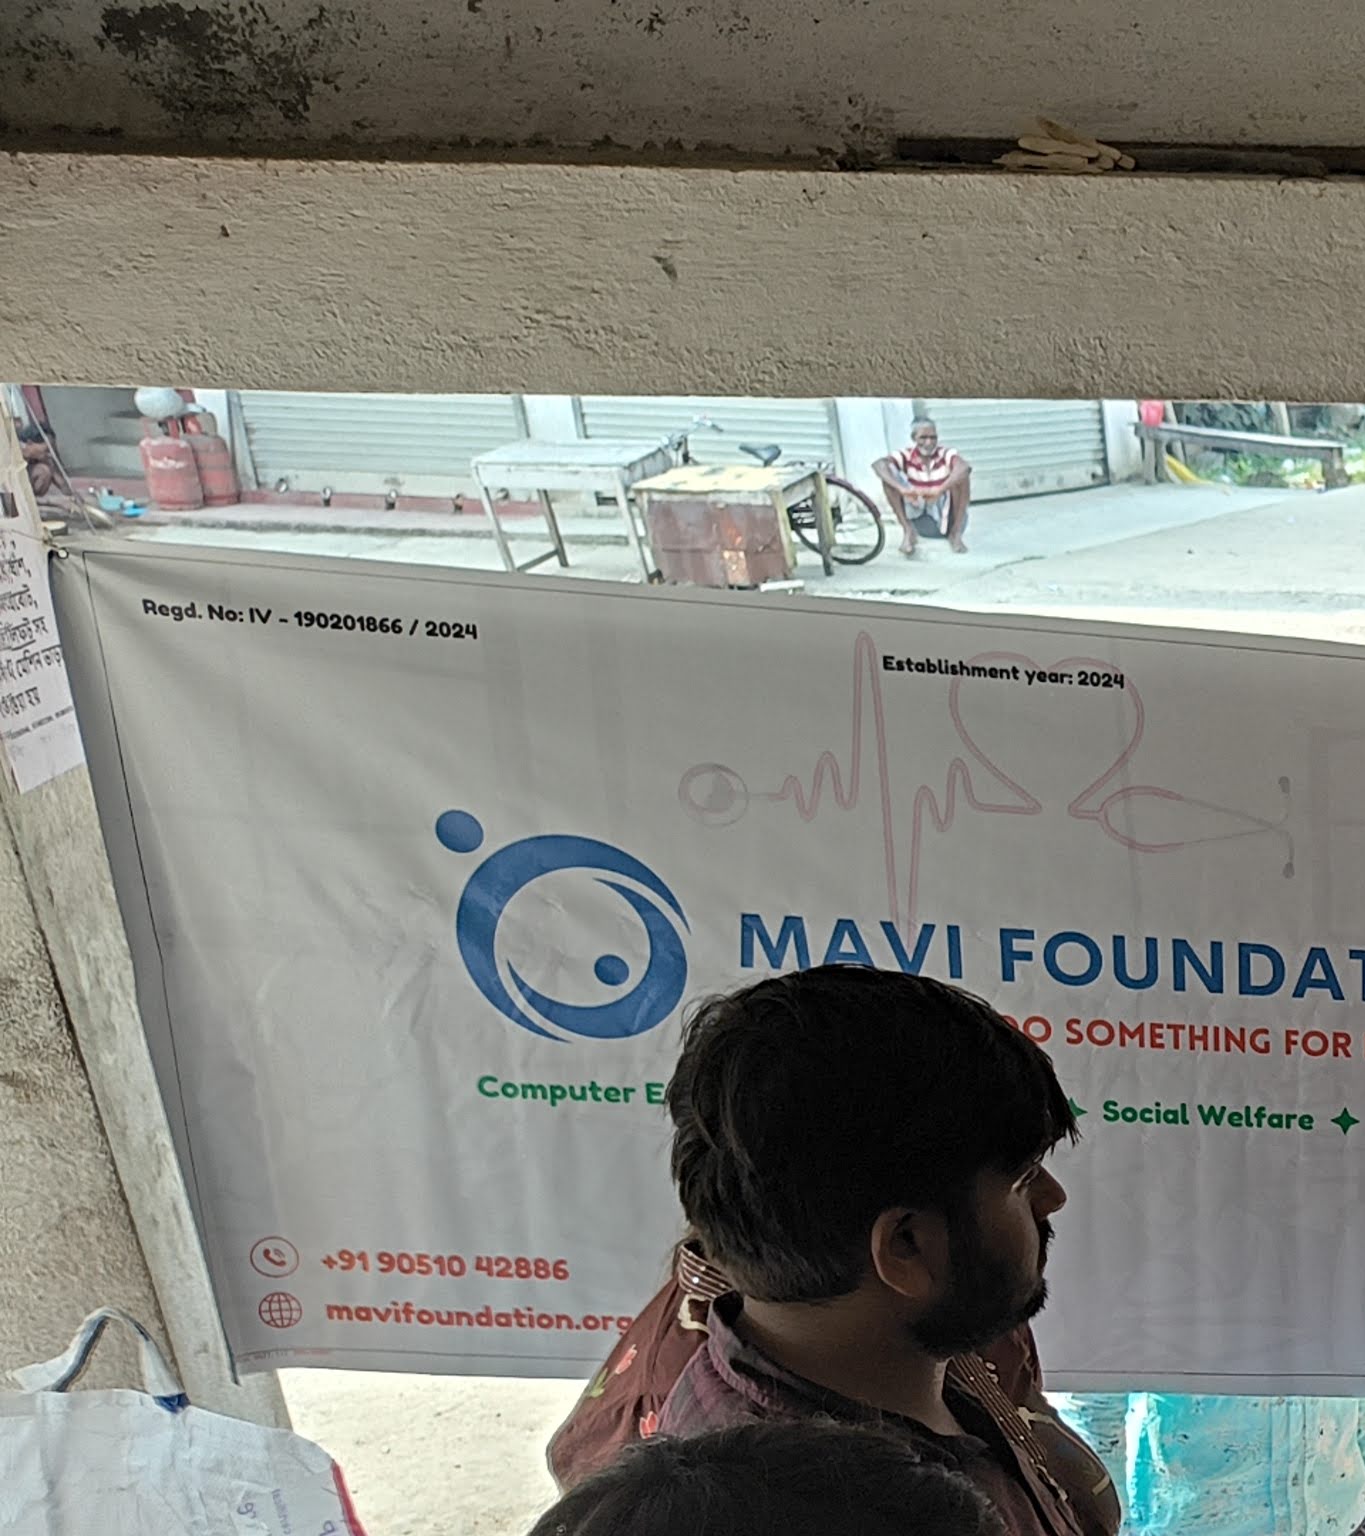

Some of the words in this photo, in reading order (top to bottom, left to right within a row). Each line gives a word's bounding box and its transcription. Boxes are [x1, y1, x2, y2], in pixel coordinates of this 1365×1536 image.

[141, 598, 203, 622] Regd.
[207, 603, 244, 623] No:
[248, 607, 273, 625] IV
[293, 610, 404, 635] 190201866
[408, 618, 420, 637] /
[424, 620, 478, 640] 2024
[882, 655, 1020, 681] Establishment
[1023, 669, 1074, 686] year:
[1077, 670, 1125, 690] 2024
[741, 913, 962, 980] MAVI
[1065, 1017, 1272, 1056] SOMETHING
[1284, 1028, 1353, 1059] FOR
[475, 1073, 638, 1109] Computer
[1102, 1098, 1190, 1126] Social
[1197, 1104, 1314, 1131] Welfare
[321, 1248, 371, 1273] +91
[377, 1252, 468, 1278] 90510
[474, 1256, 570, 1281] 42886
[326, 1299, 633, 1335] mavifoundation.org
